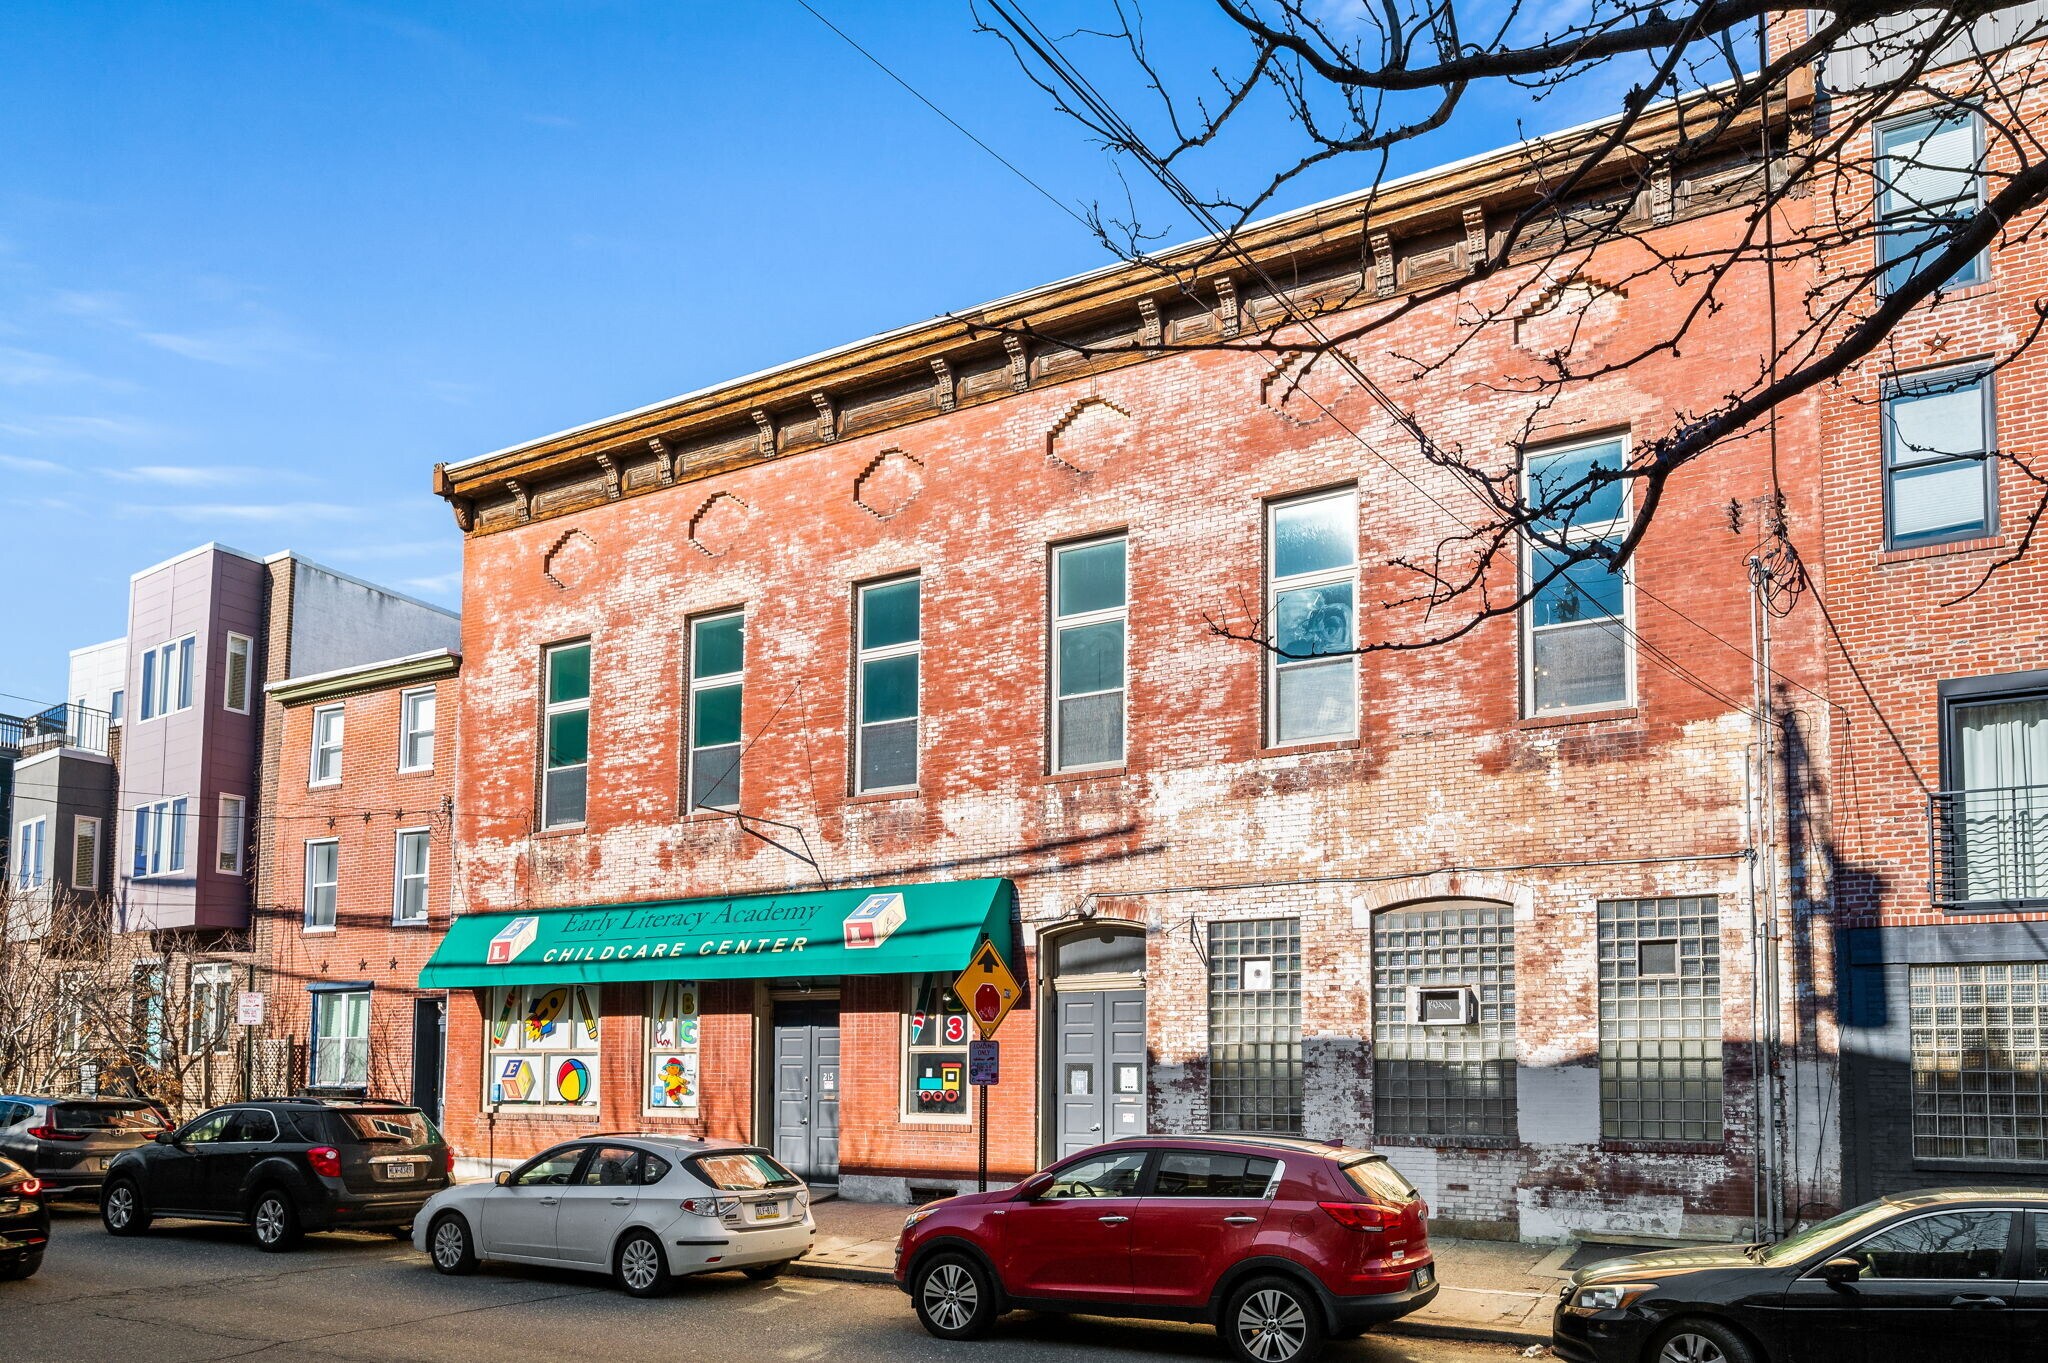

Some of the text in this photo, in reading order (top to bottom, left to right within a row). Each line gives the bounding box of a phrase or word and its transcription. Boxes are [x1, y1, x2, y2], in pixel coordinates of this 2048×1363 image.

[560, 900, 823, 937] Early Literacy Academy
[543, 937, 808, 962] CHILDCARE CENTER
[946, 1016, 965, 1042] 3
[823, 1072, 834, 1081] 215
